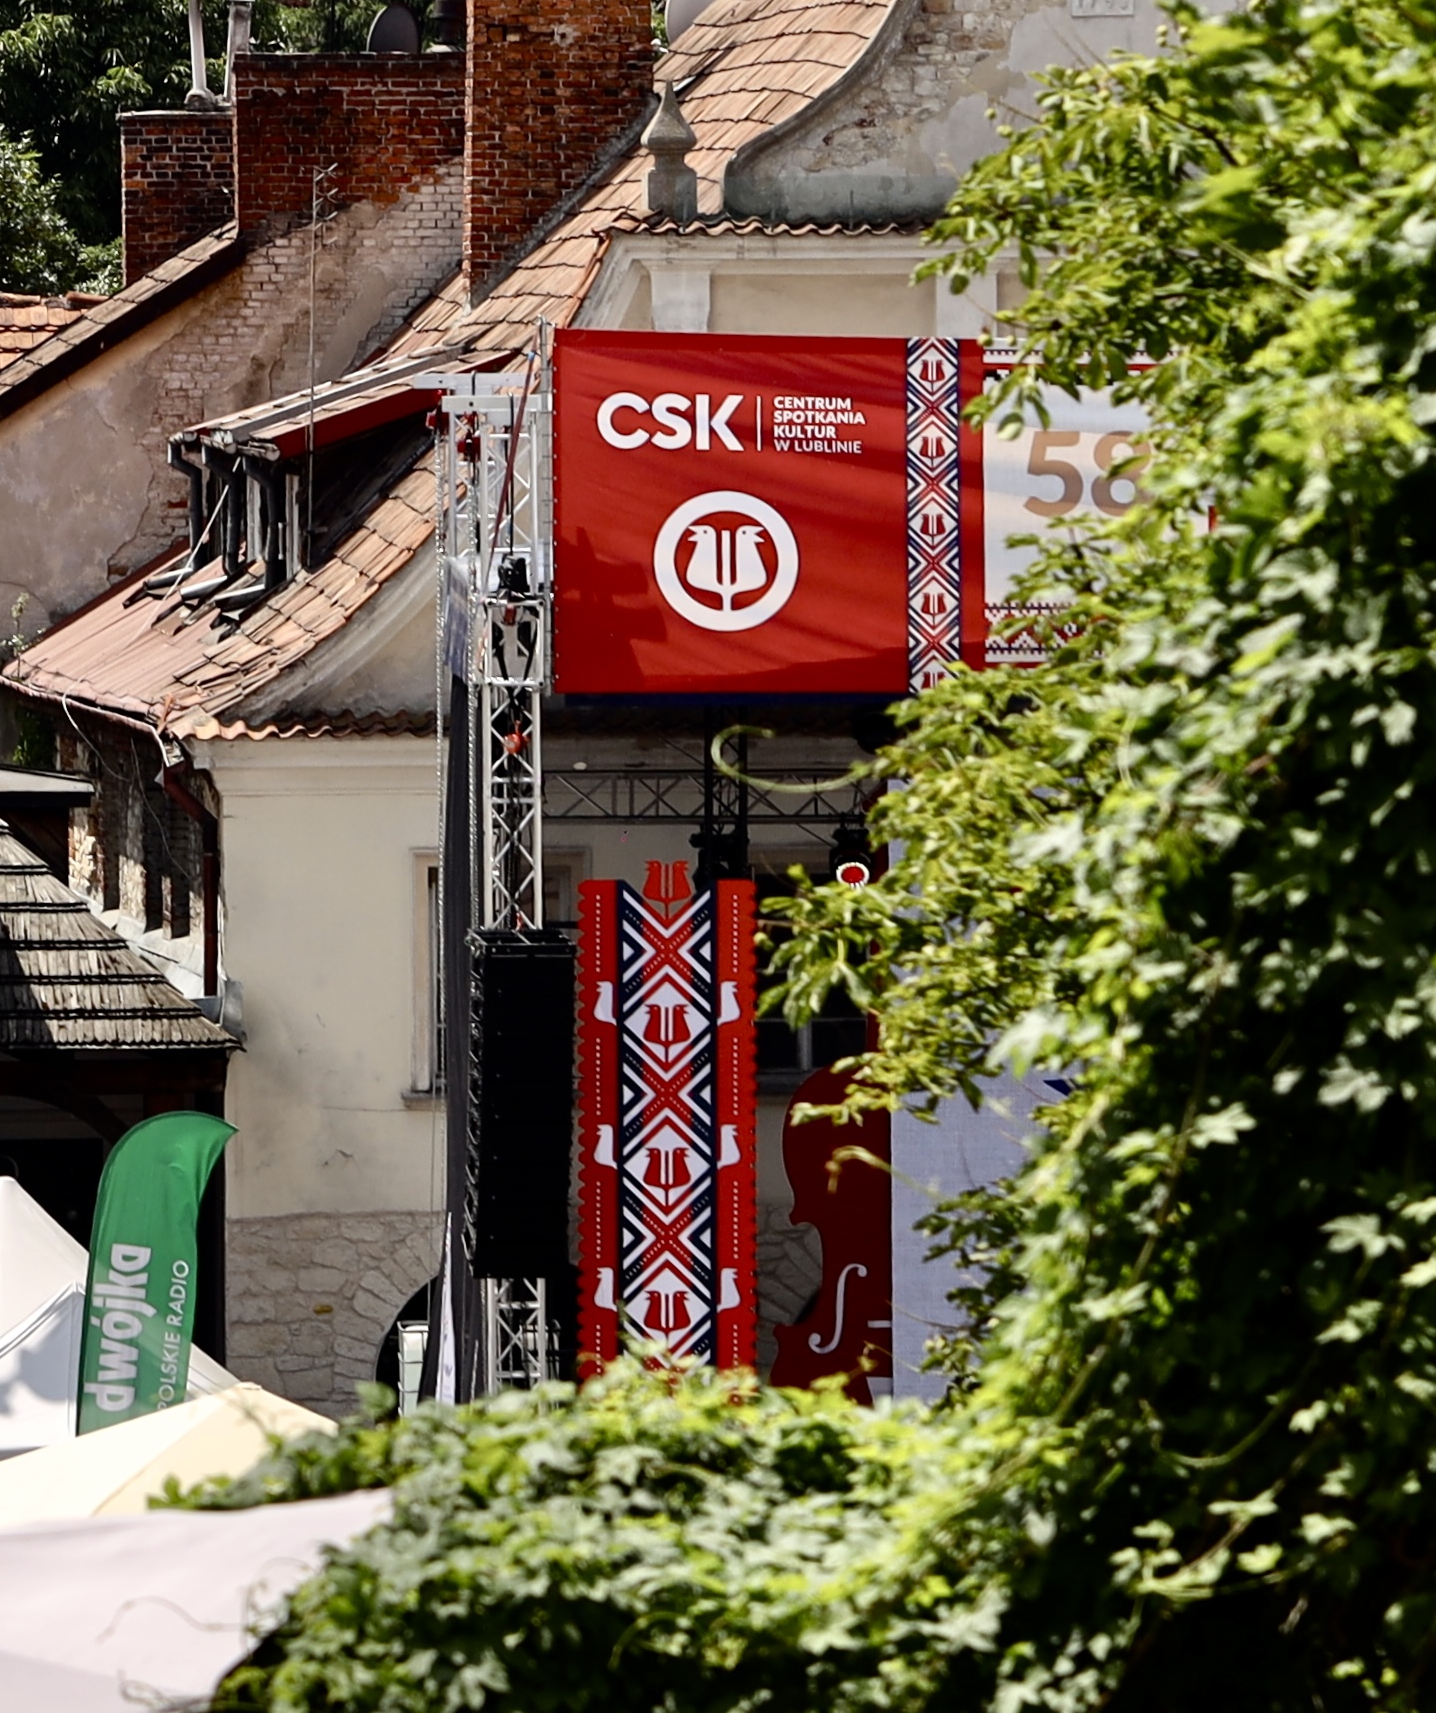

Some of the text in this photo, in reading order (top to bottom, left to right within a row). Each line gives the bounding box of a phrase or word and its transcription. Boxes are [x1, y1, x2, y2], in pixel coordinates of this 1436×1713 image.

[596, 391, 744, 452] CSK
[773, 396, 852, 411] CENTRUM
[773, 410, 866, 425] SPOTKANIA
[773, 424, 837, 439] KULTUR
[774, 439, 862, 455] W LUBLINIE
[1023, 430, 1154, 518] 58
[166, 1259, 190, 1327] RADIO
[84, 1243, 158, 1413] dwójka
